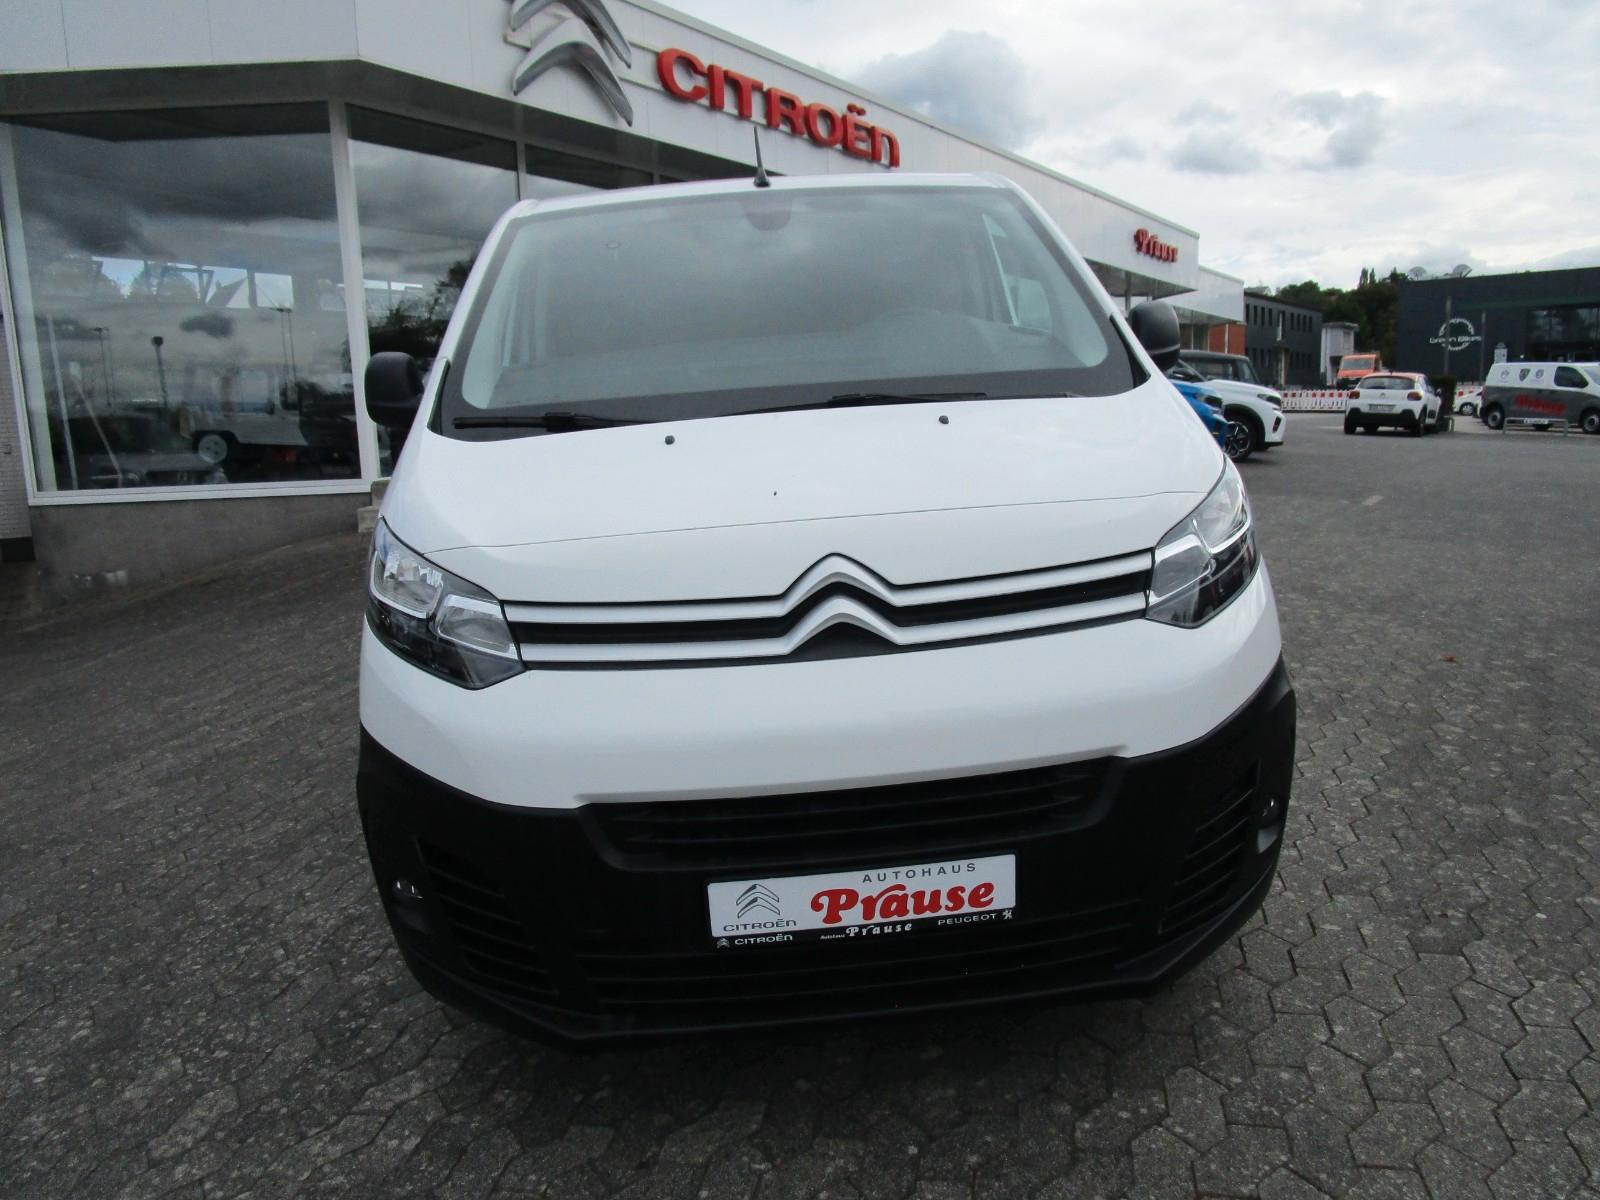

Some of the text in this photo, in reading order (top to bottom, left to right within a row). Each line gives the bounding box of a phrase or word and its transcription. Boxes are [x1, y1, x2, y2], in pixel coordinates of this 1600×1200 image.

[863, 862, 976, 883] AUTOHAUS
[810, 882, 994, 924] Prause
[937, 912, 996, 925] PEUGEOT
[846, 923, 912, 936] Prause
